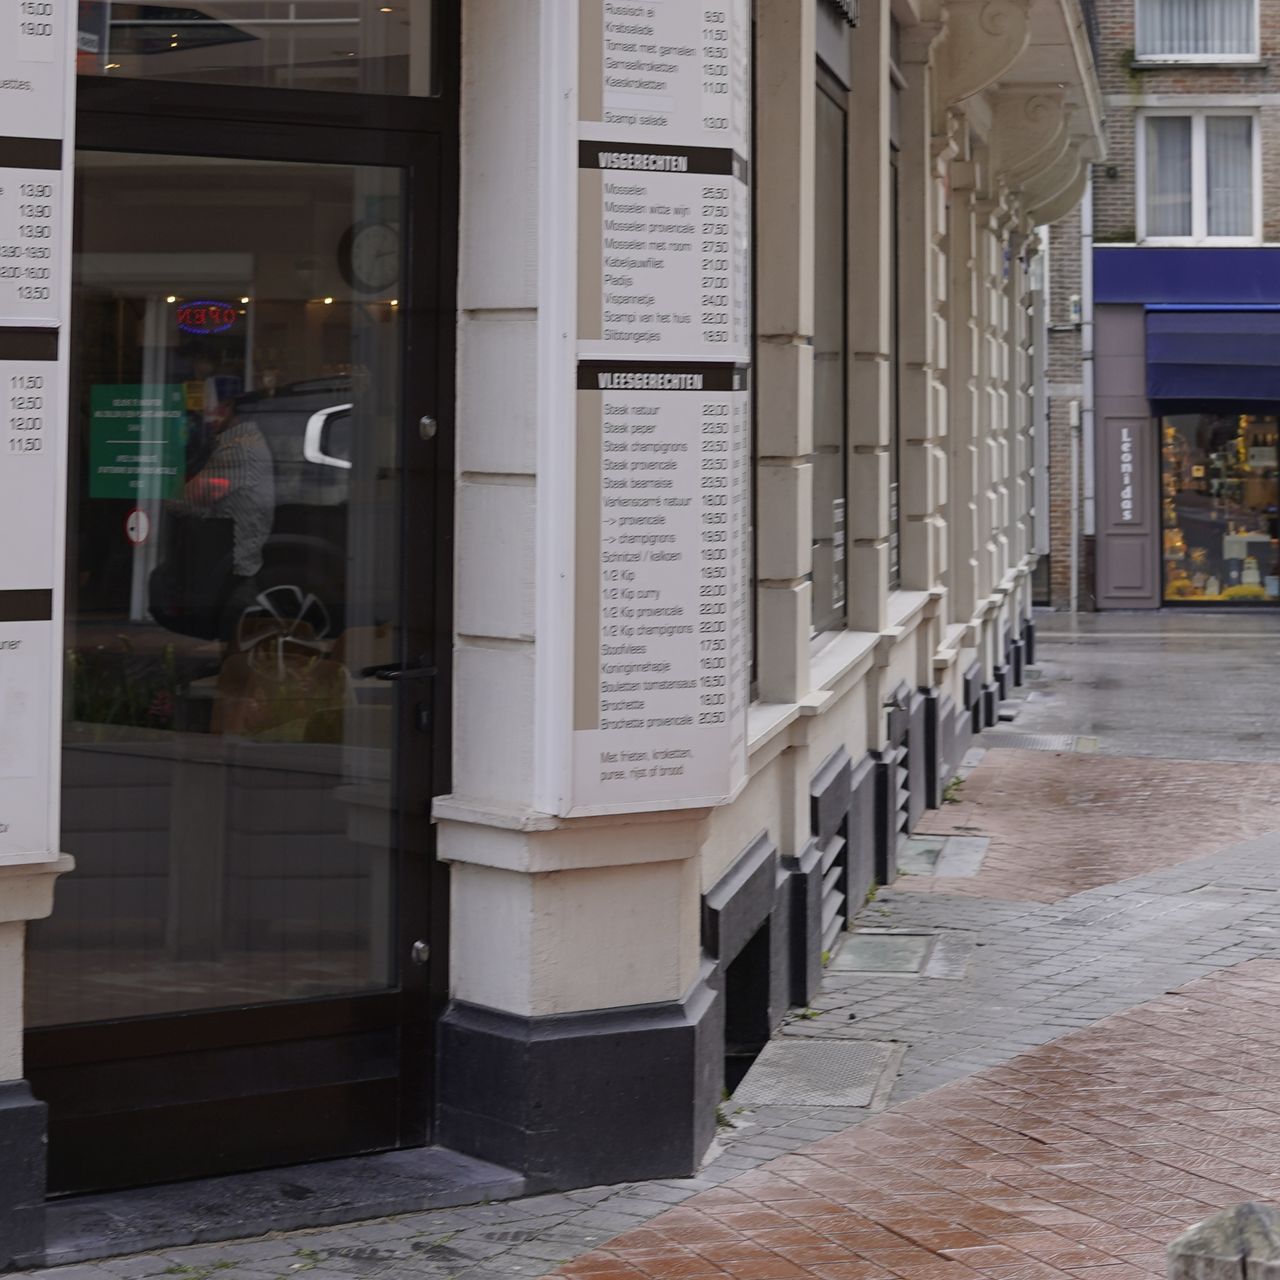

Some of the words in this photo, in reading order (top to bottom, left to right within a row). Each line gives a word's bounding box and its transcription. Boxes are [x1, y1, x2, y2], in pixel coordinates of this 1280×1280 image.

[598, 152, 688, 171] VISGERECHTEN
[598, 373, 704, 390] VLEESGERECHTEN
[1121, 428, 1133, 520] Leonidas
